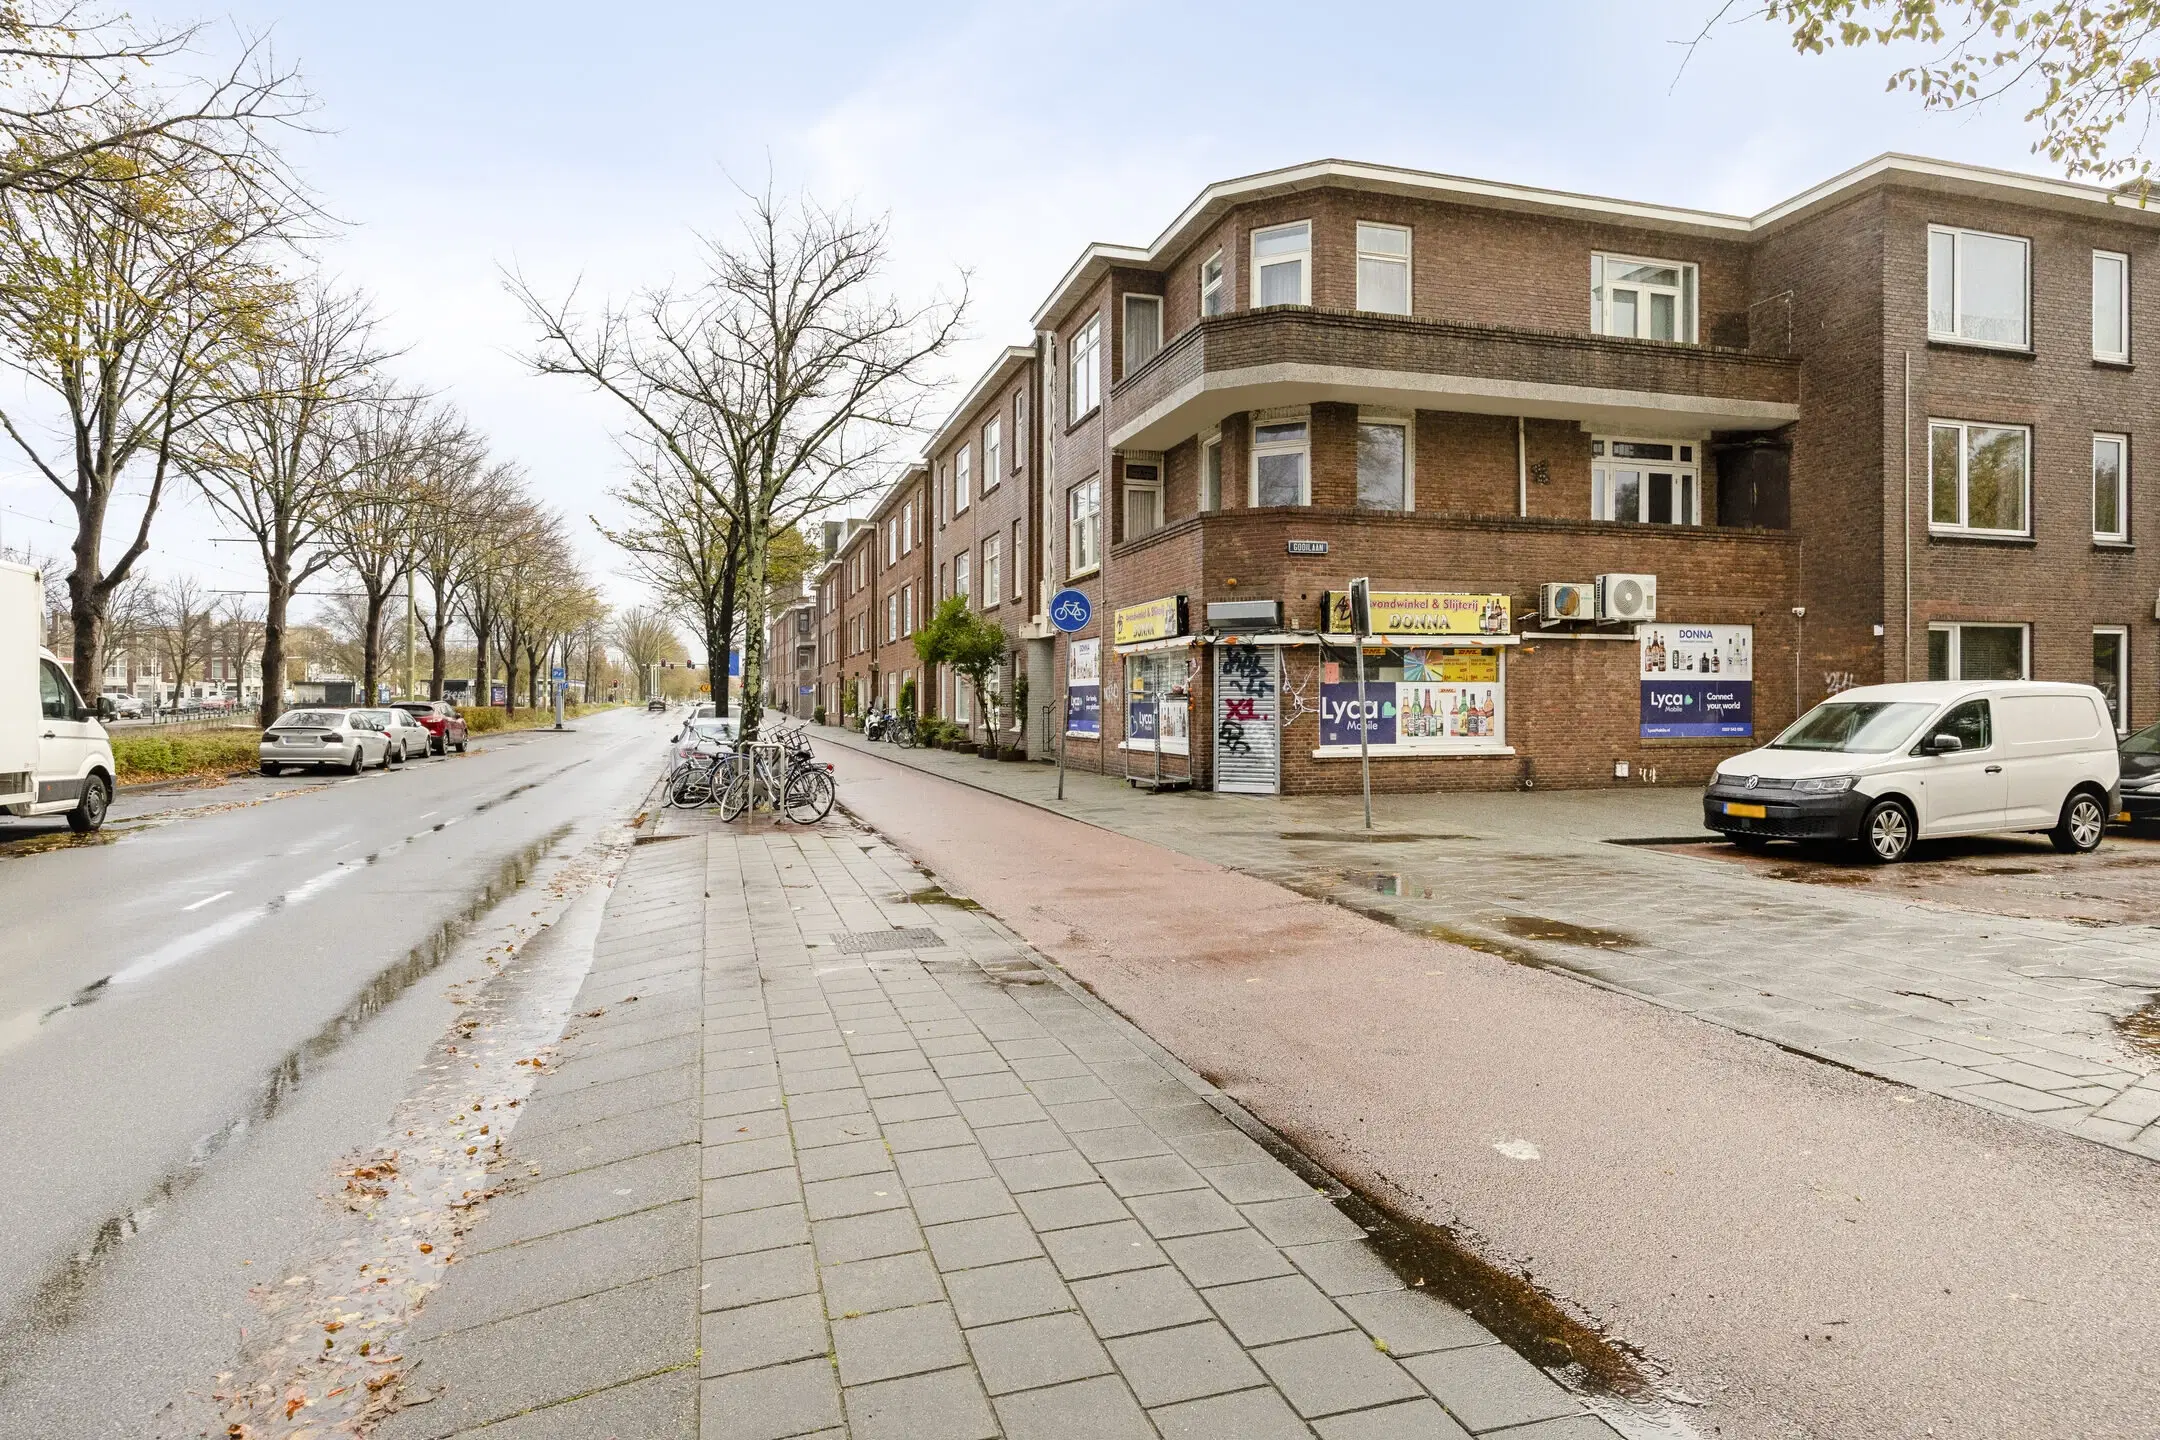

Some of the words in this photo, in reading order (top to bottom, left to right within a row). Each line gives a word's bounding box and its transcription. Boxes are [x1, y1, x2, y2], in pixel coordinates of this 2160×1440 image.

[1370, 597, 1428, 610] vondwinkel
[1432, 599, 1440, 609] &
[1443, 598, 1479, 613] Slijterij
[1389, 613, 1452, 630] DONNA
[1679, 629, 1713, 639] DONNA
[1650, 691, 1683, 709] Lyca
[1706, 692, 1734, 701] Connect
[1321, 696, 1379, 724] Lyca
[1706, 703, 1722, 712] your
[1722, 701, 1741, 710] world
[1138, 711, 1153, 727] Lyca
[1346, 720, 1378, 731] Moile
